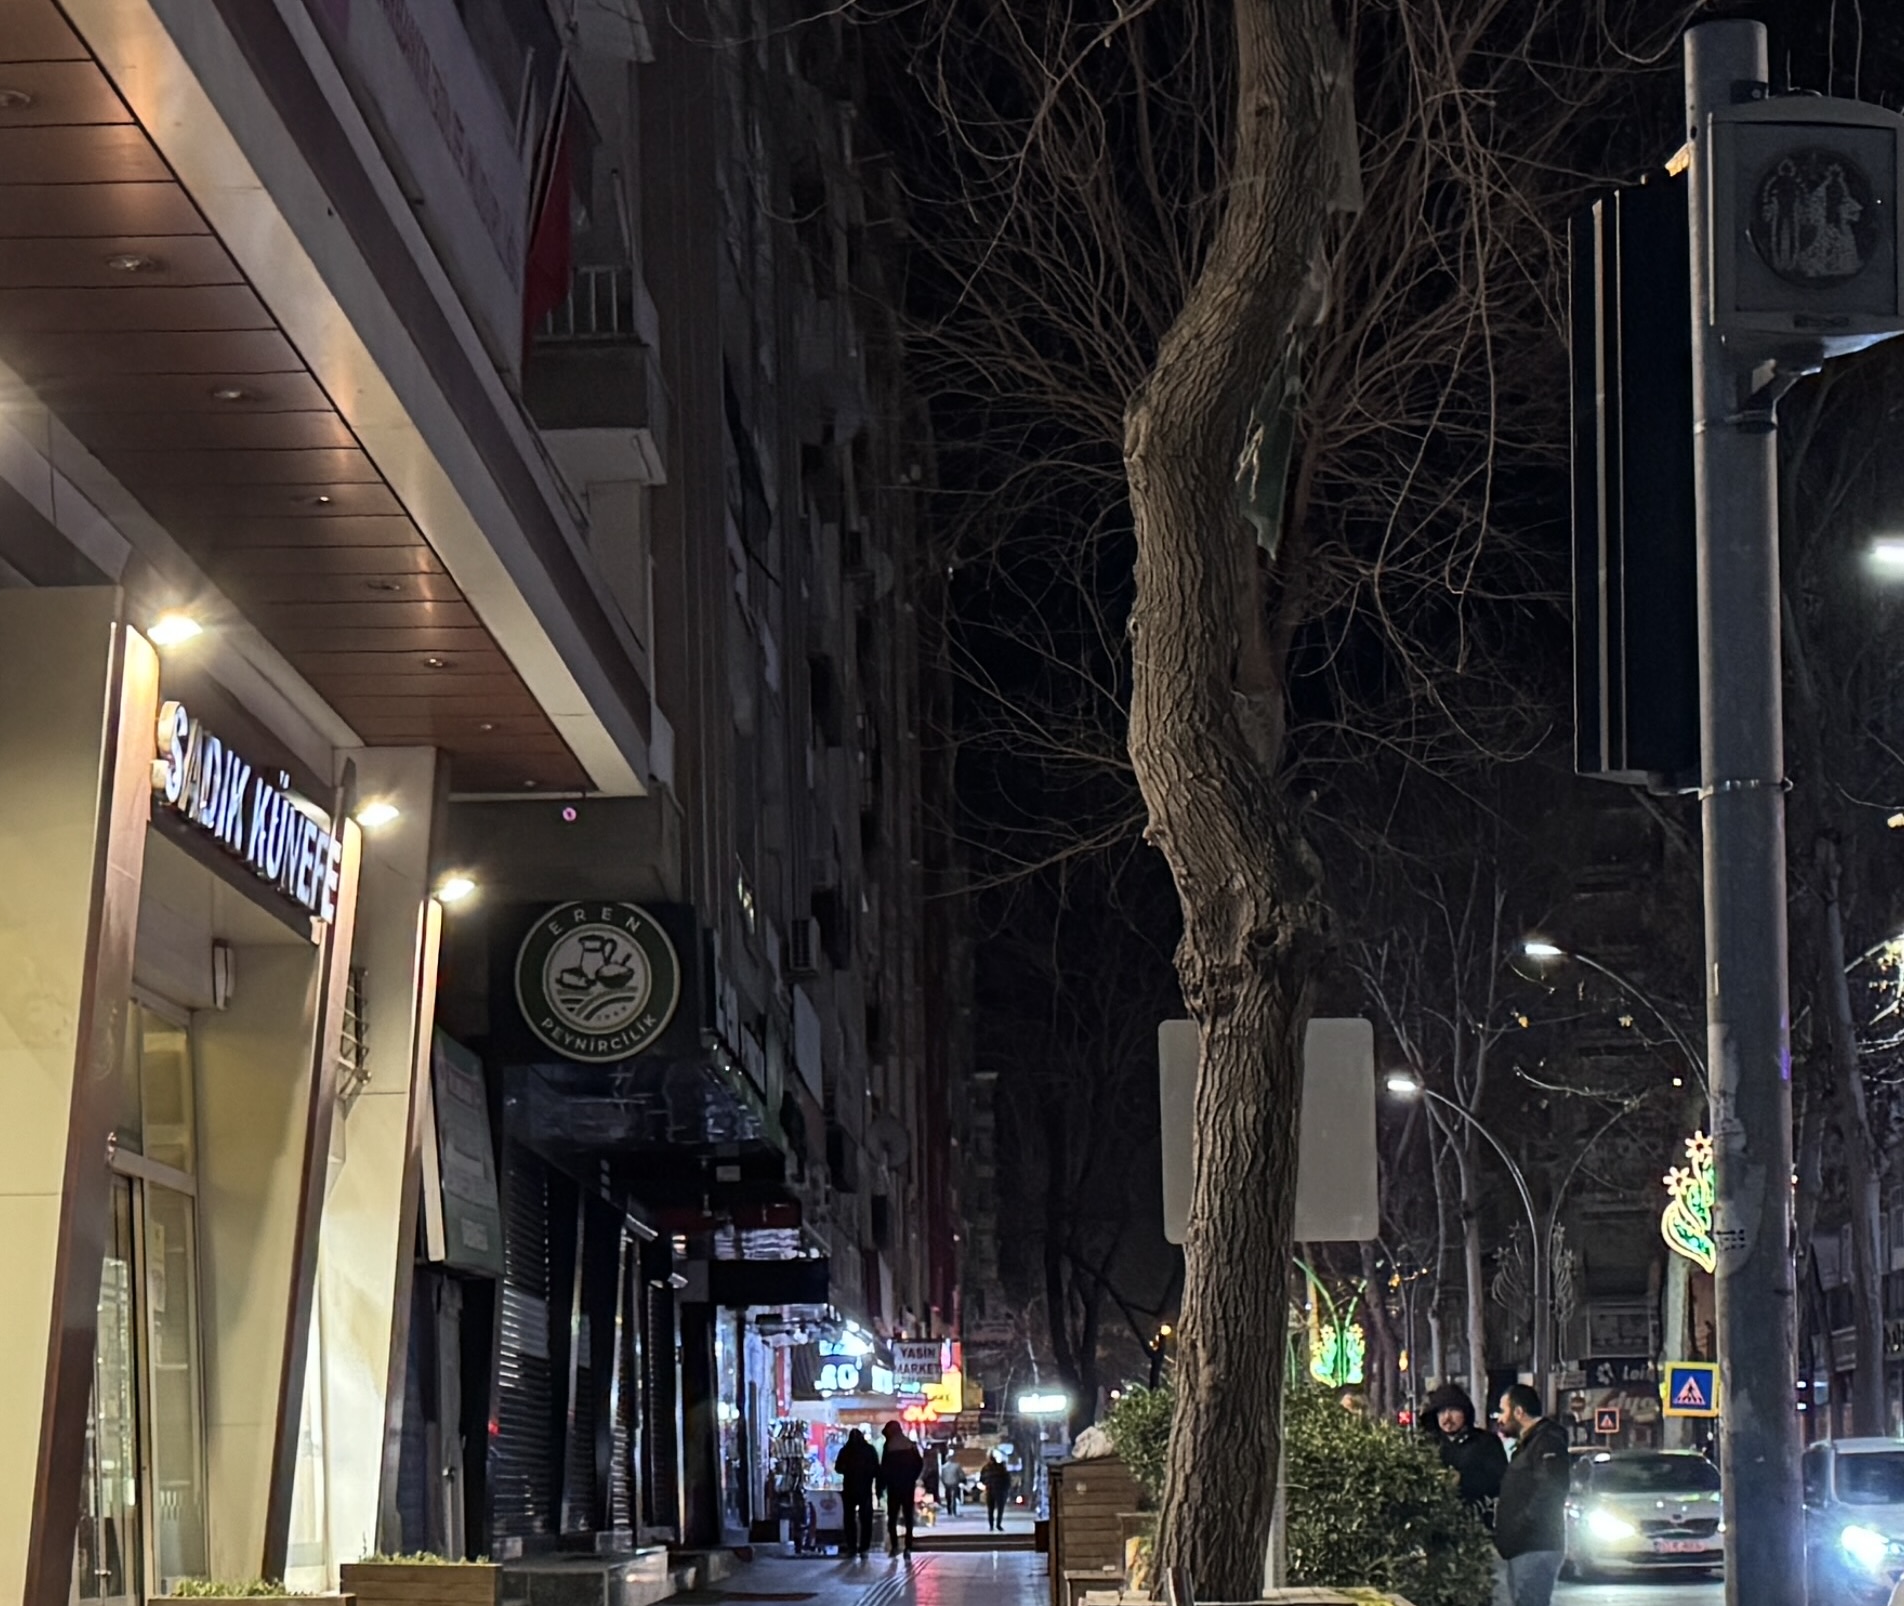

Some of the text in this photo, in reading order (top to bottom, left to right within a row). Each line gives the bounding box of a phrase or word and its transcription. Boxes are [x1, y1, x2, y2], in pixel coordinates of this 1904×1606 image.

[158, 701, 342, 924] SADIK KÜNEFE
[548, 907, 641, 936] EREN
[541, 1014, 657, 1052] PEYNİRCİLİK
[900, 1343, 935, 1360] YASİN
